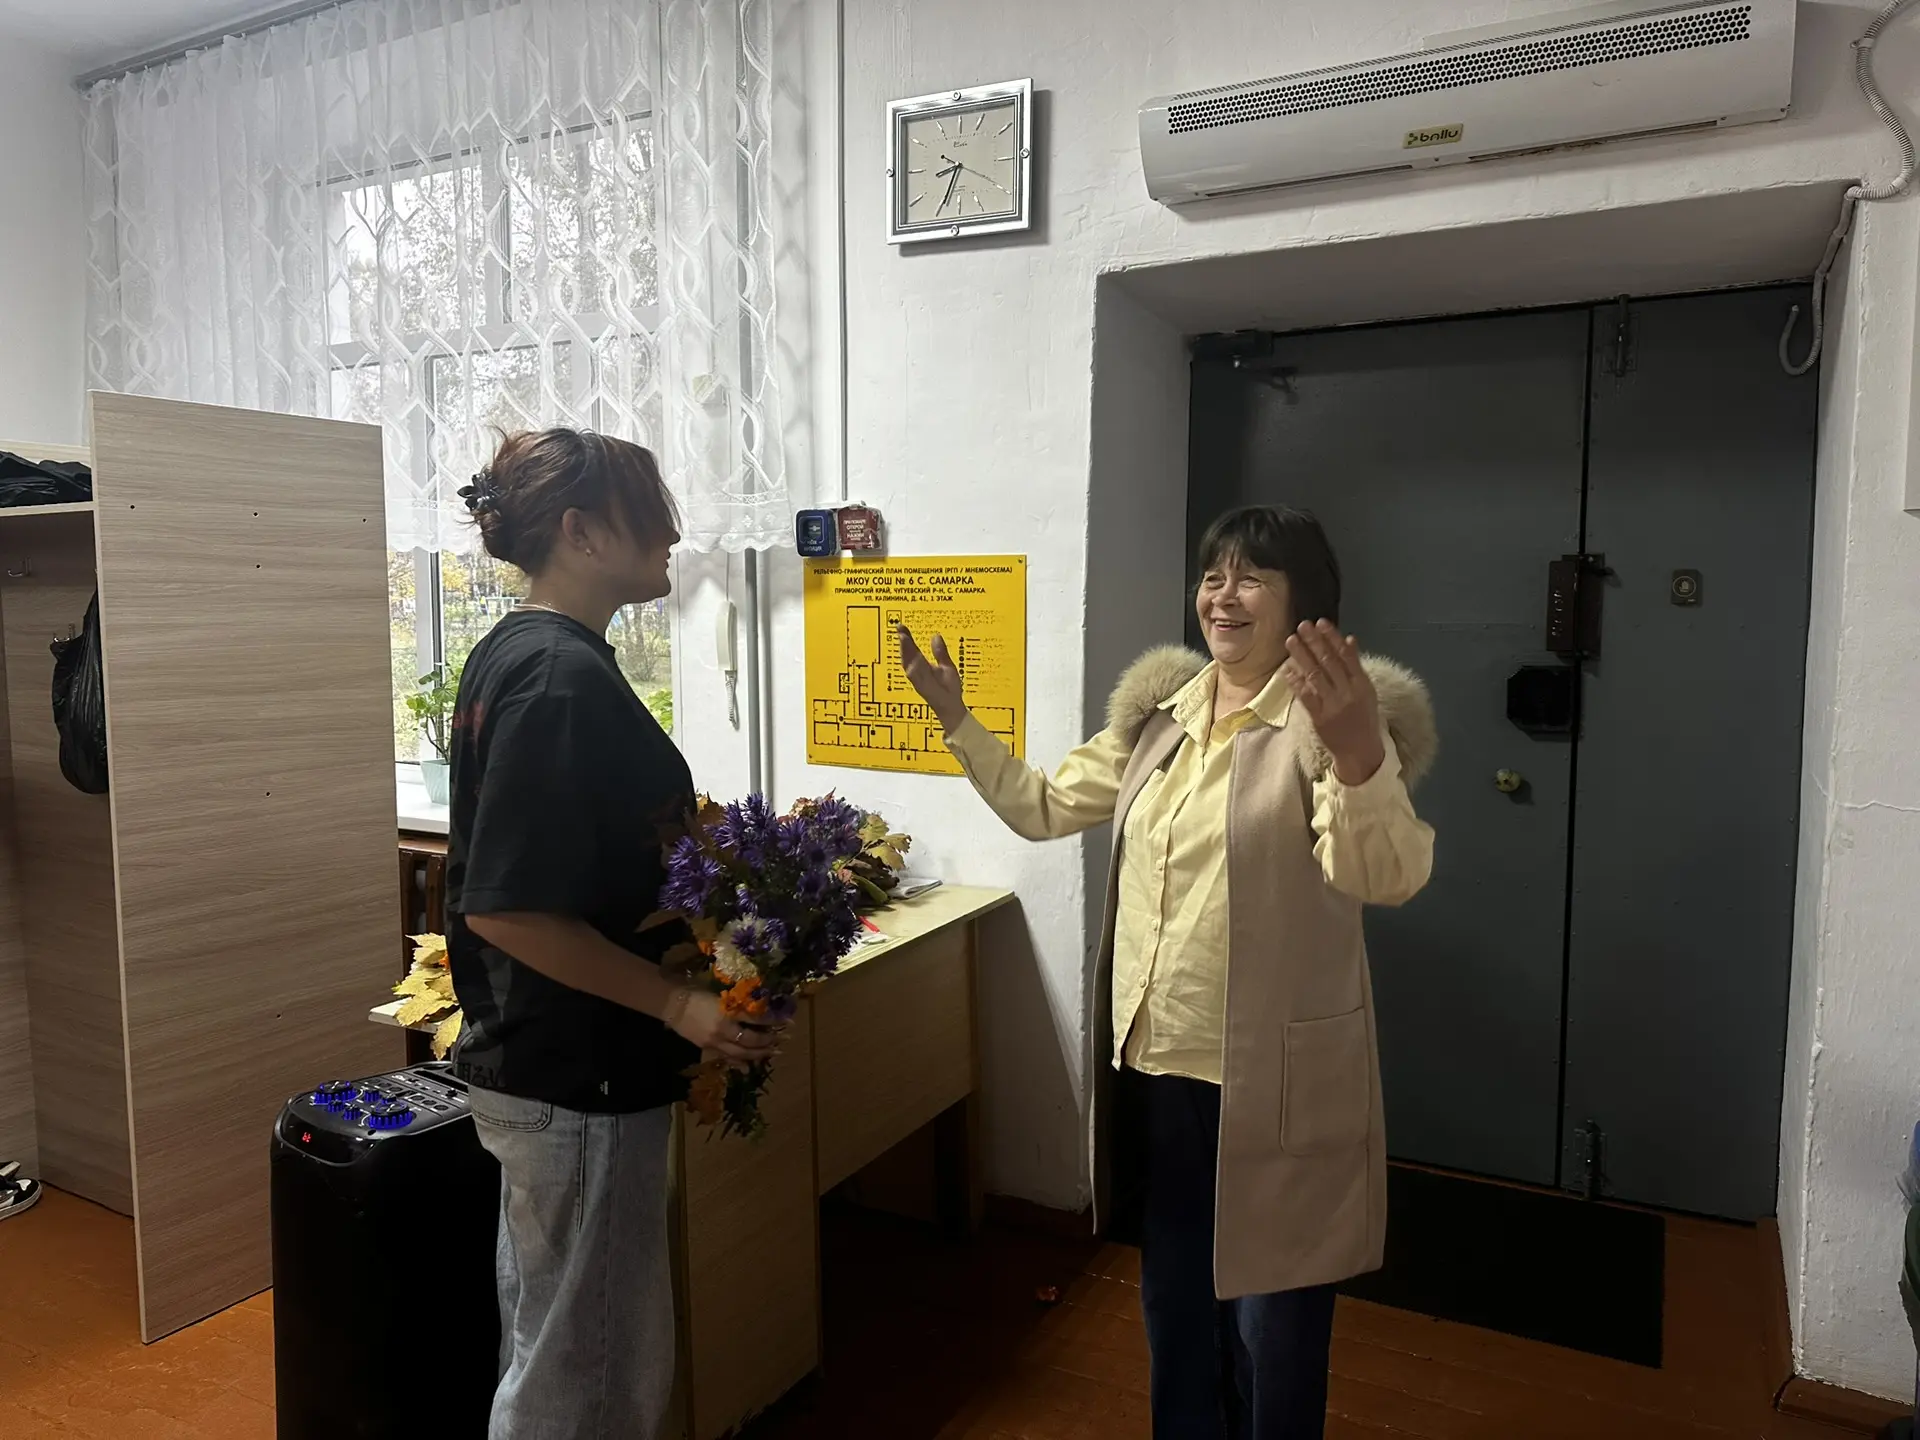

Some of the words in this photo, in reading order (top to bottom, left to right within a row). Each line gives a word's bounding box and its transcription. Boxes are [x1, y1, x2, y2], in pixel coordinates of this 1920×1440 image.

[813, 567, 884, 575] РЕЛЬЕФНО-ГРАФИЧЕСКИЙ
[846, 576, 870, 586] МКОУ
[872, 576, 892, 585] СОШ
[896, 576, 905, 585] №
[909, 576, 914, 585] 6
[917, 576, 926, 585] С.
[929, 576, 974, 585] САМАРКА
[875, 587, 891, 595] КРАЙ,
[875, 595, 909, 603] КАЛИНИНА,
